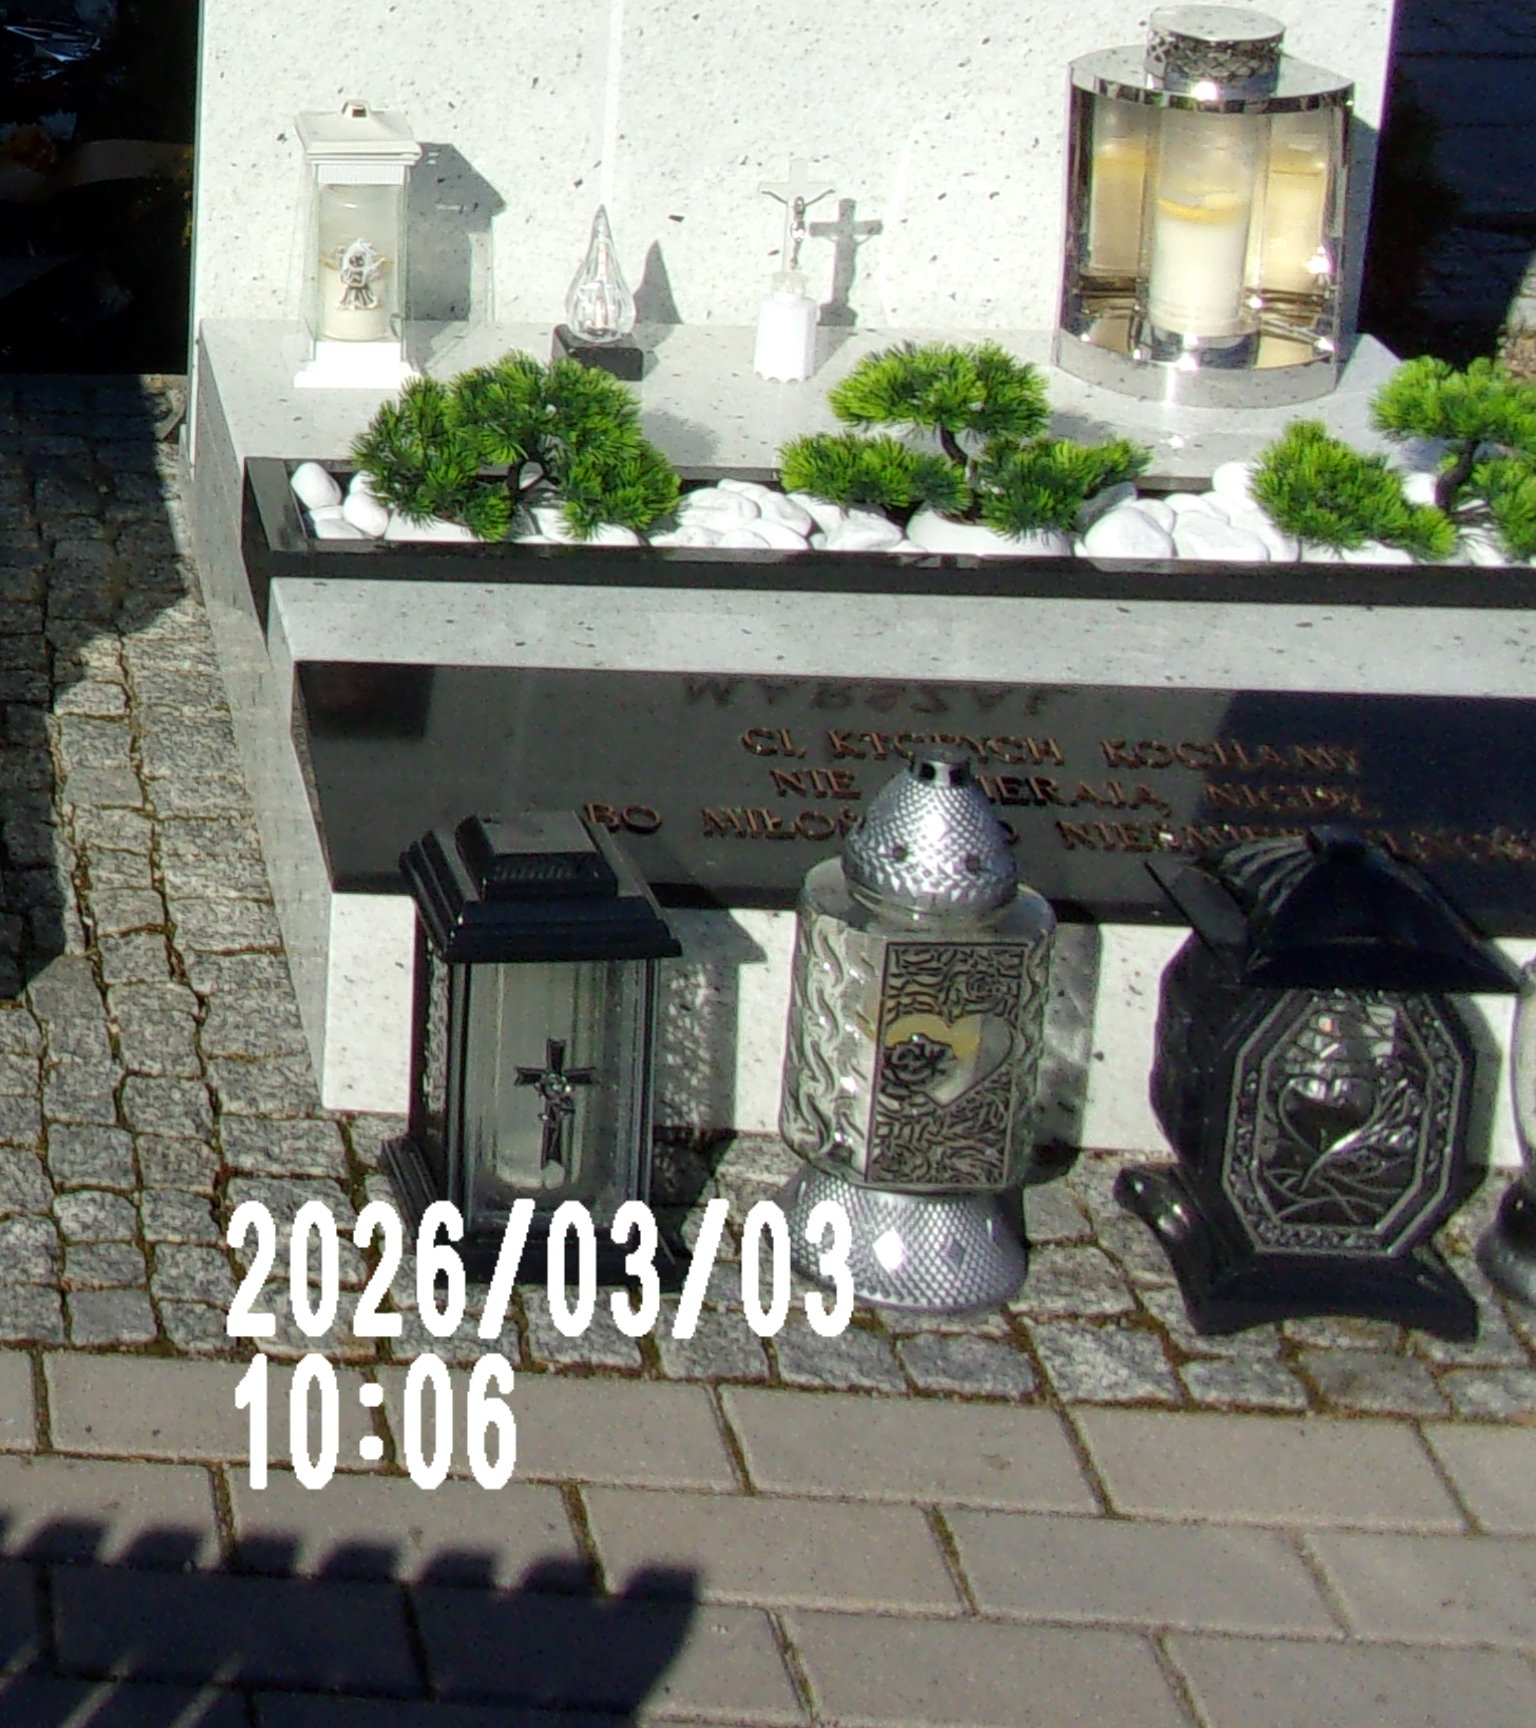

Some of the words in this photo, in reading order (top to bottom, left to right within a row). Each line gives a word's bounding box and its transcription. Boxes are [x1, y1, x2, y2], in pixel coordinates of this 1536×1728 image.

[1101, 738, 1362, 775] KOCHAMY
[770, 767, 863, 801] NIE
[583, 802, 663, 834] BO
